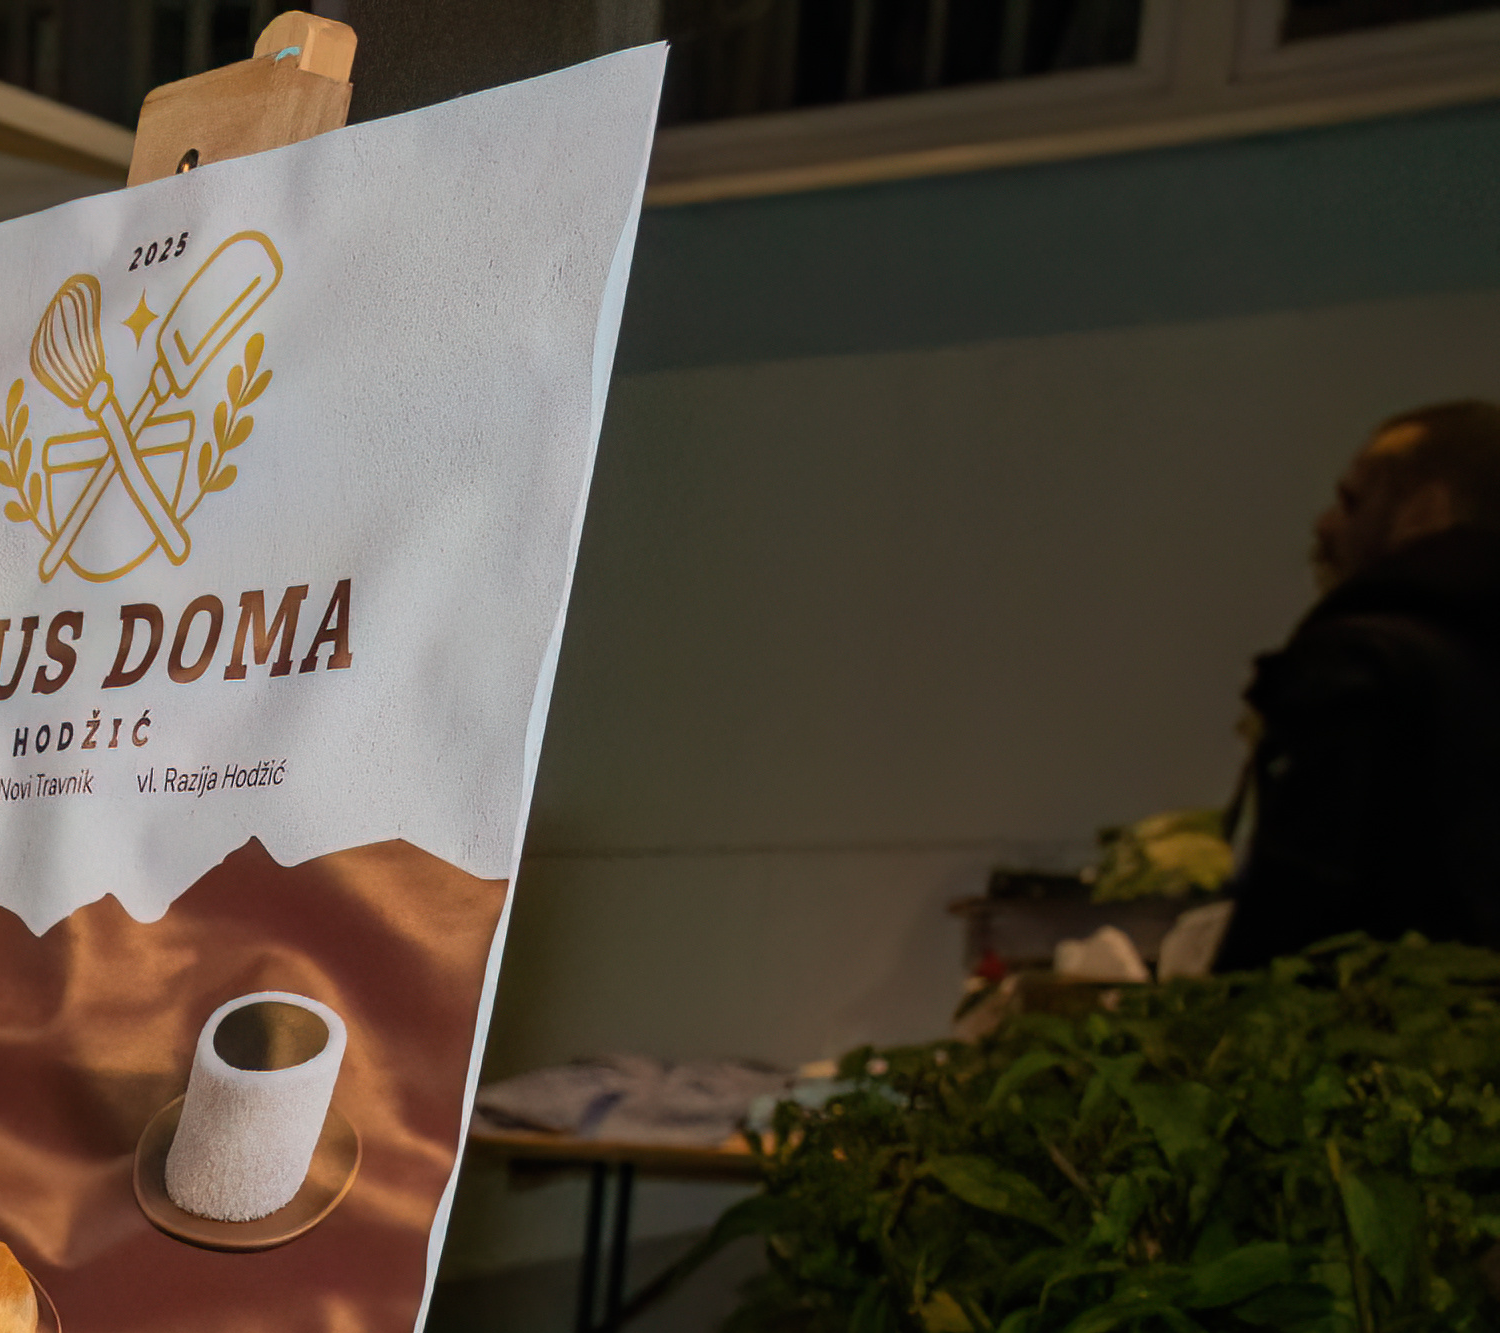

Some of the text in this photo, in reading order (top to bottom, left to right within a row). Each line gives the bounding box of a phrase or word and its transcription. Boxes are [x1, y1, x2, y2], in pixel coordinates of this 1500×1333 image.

[127, 231, 189, 272] 2025
[101, 578, 353, 689] DOMA
[13, 708, 152, 757] HODŽIĆ
[37, 769, 95, 799] Travnik
[137, 769, 158, 794] vl.
[164, 767, 218, 799] Razija
[221, 759, 288, 790] Hodžić
